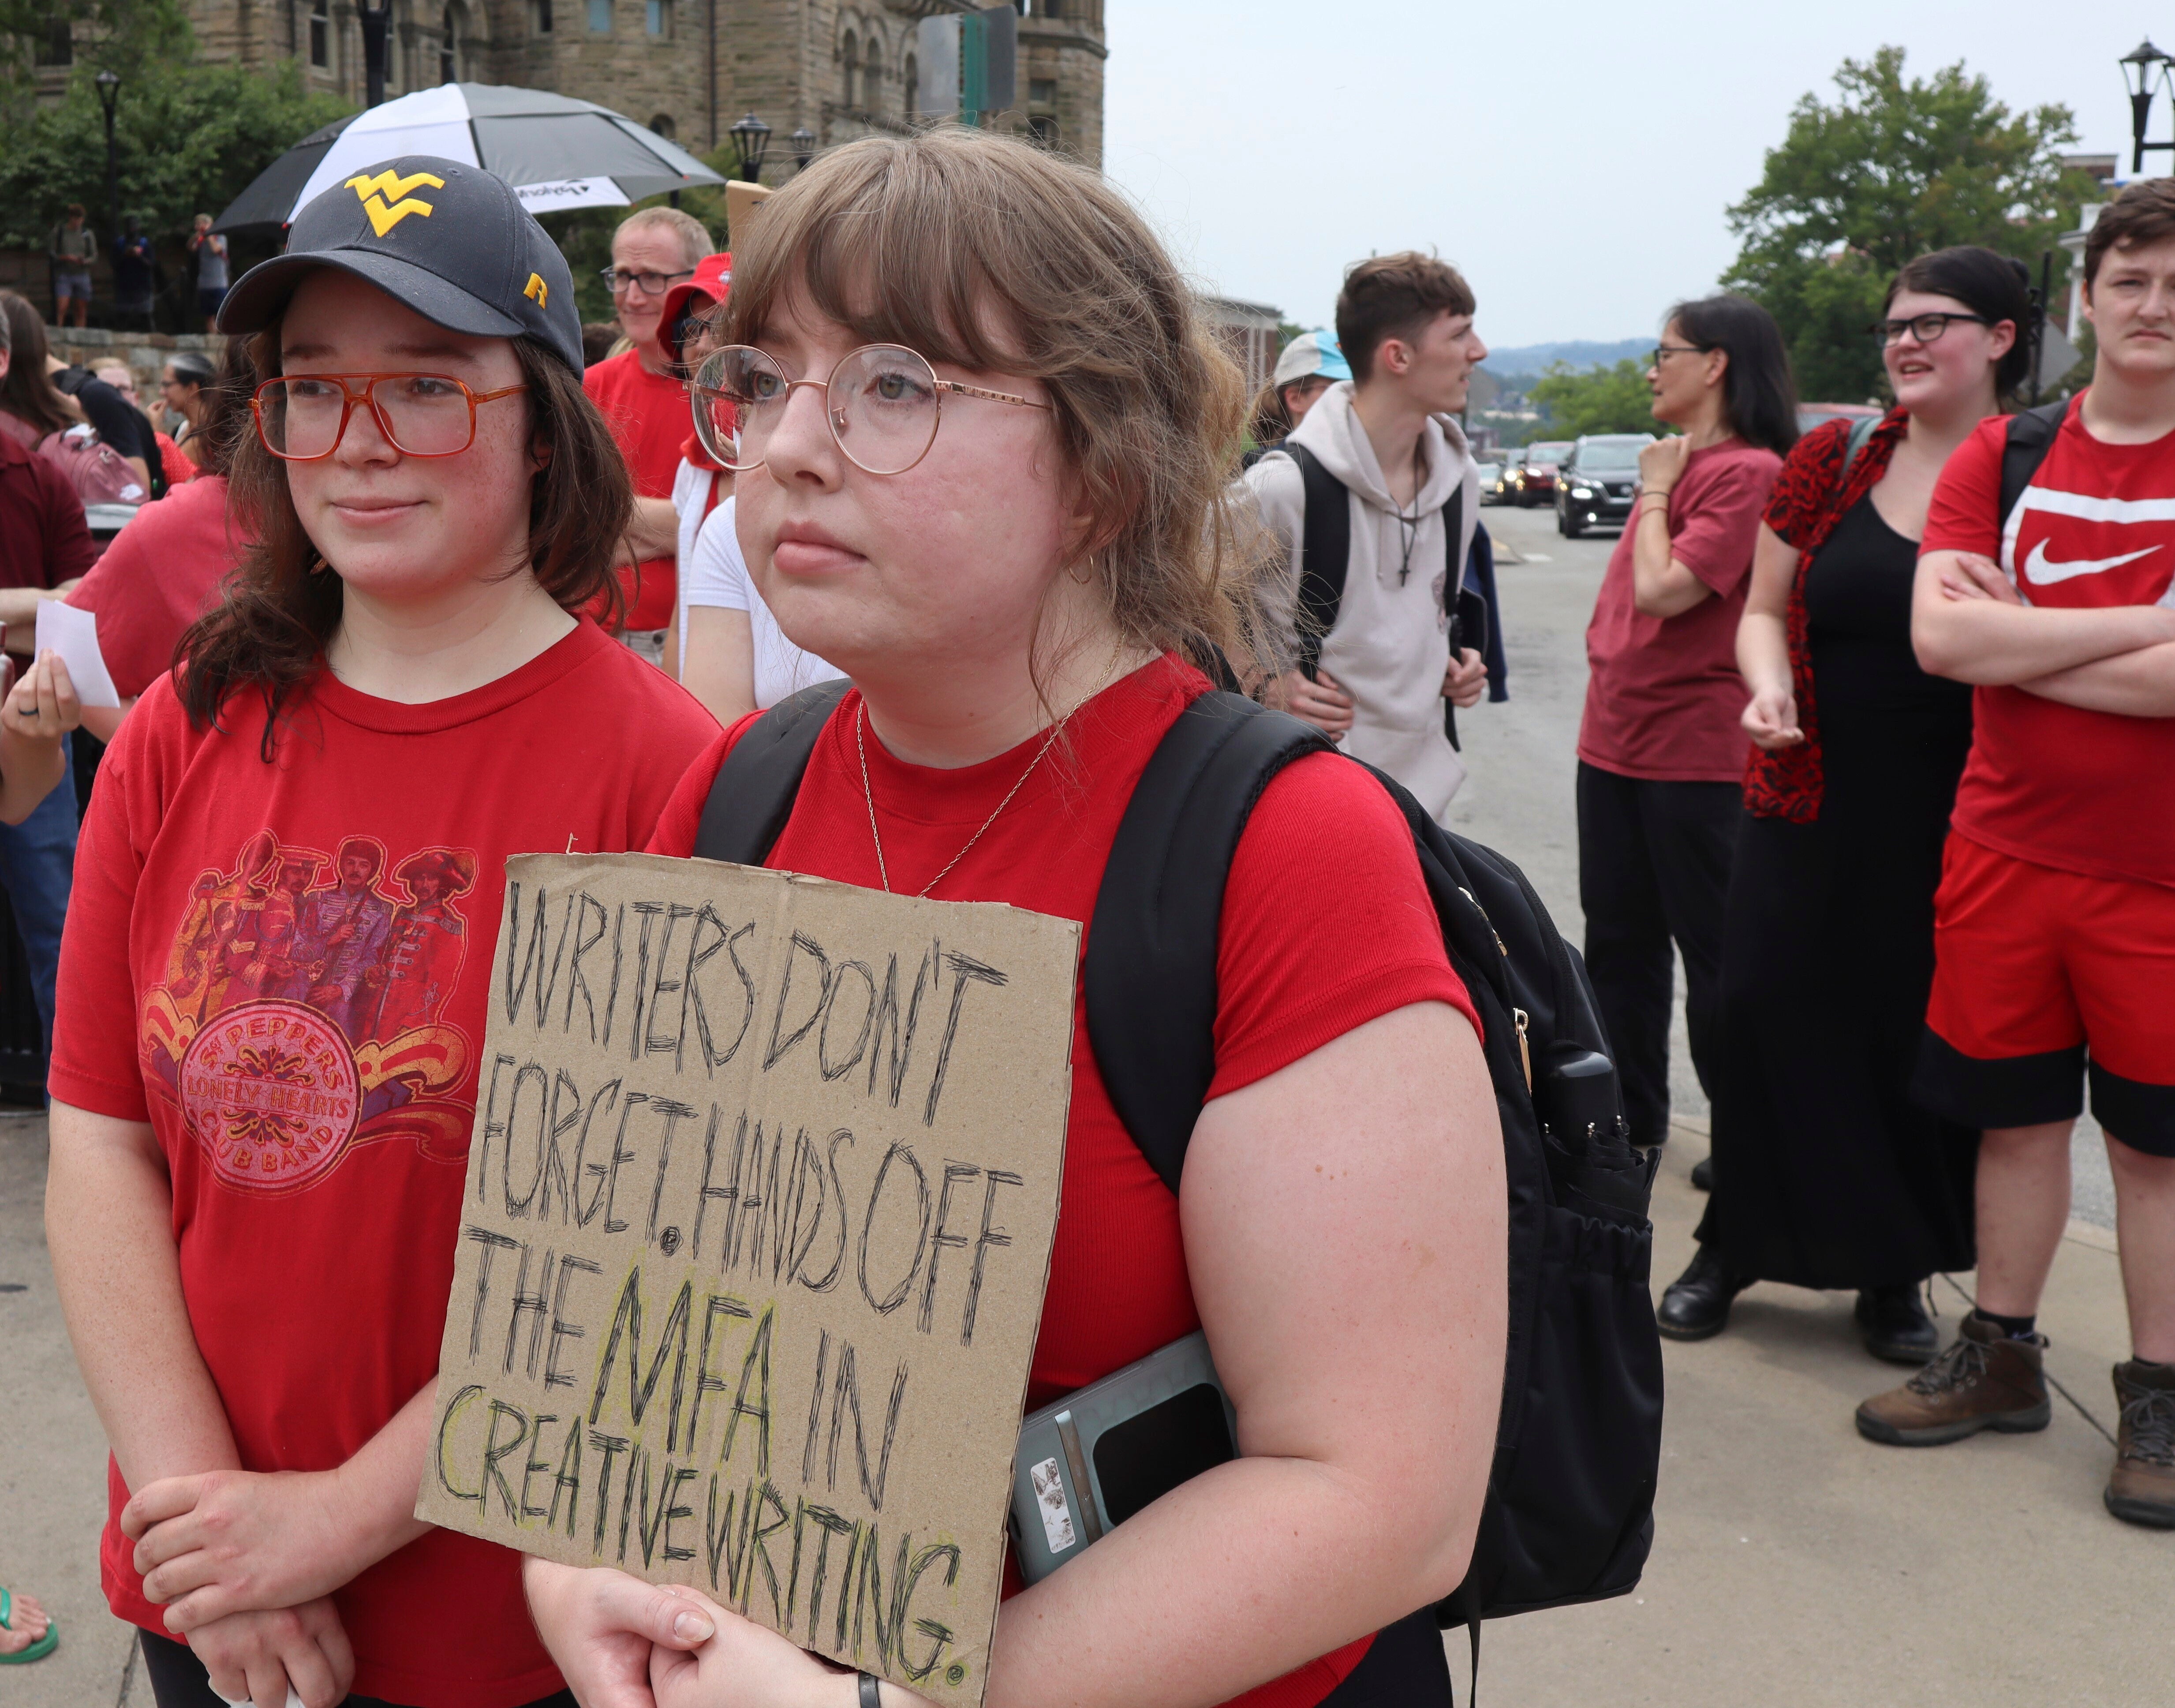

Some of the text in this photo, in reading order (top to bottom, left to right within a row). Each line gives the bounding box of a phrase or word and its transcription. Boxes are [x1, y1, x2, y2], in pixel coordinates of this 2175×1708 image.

[187, 1075, 350, 1118] LONELY HEARTS
[225, 1017, 344, 1090] PEPPERS
[507, 882, 1008, 1126] WRITERS DON'T
[200, 1109, 333, 1173] CLUB BAND
[478, 1053, 1023, 1347] FORGET. HANDS OFF
[465, 1225, 907, 1513] THE MFA IN
[437, 1385, 964, 1686] CREATIVE WRITING.
